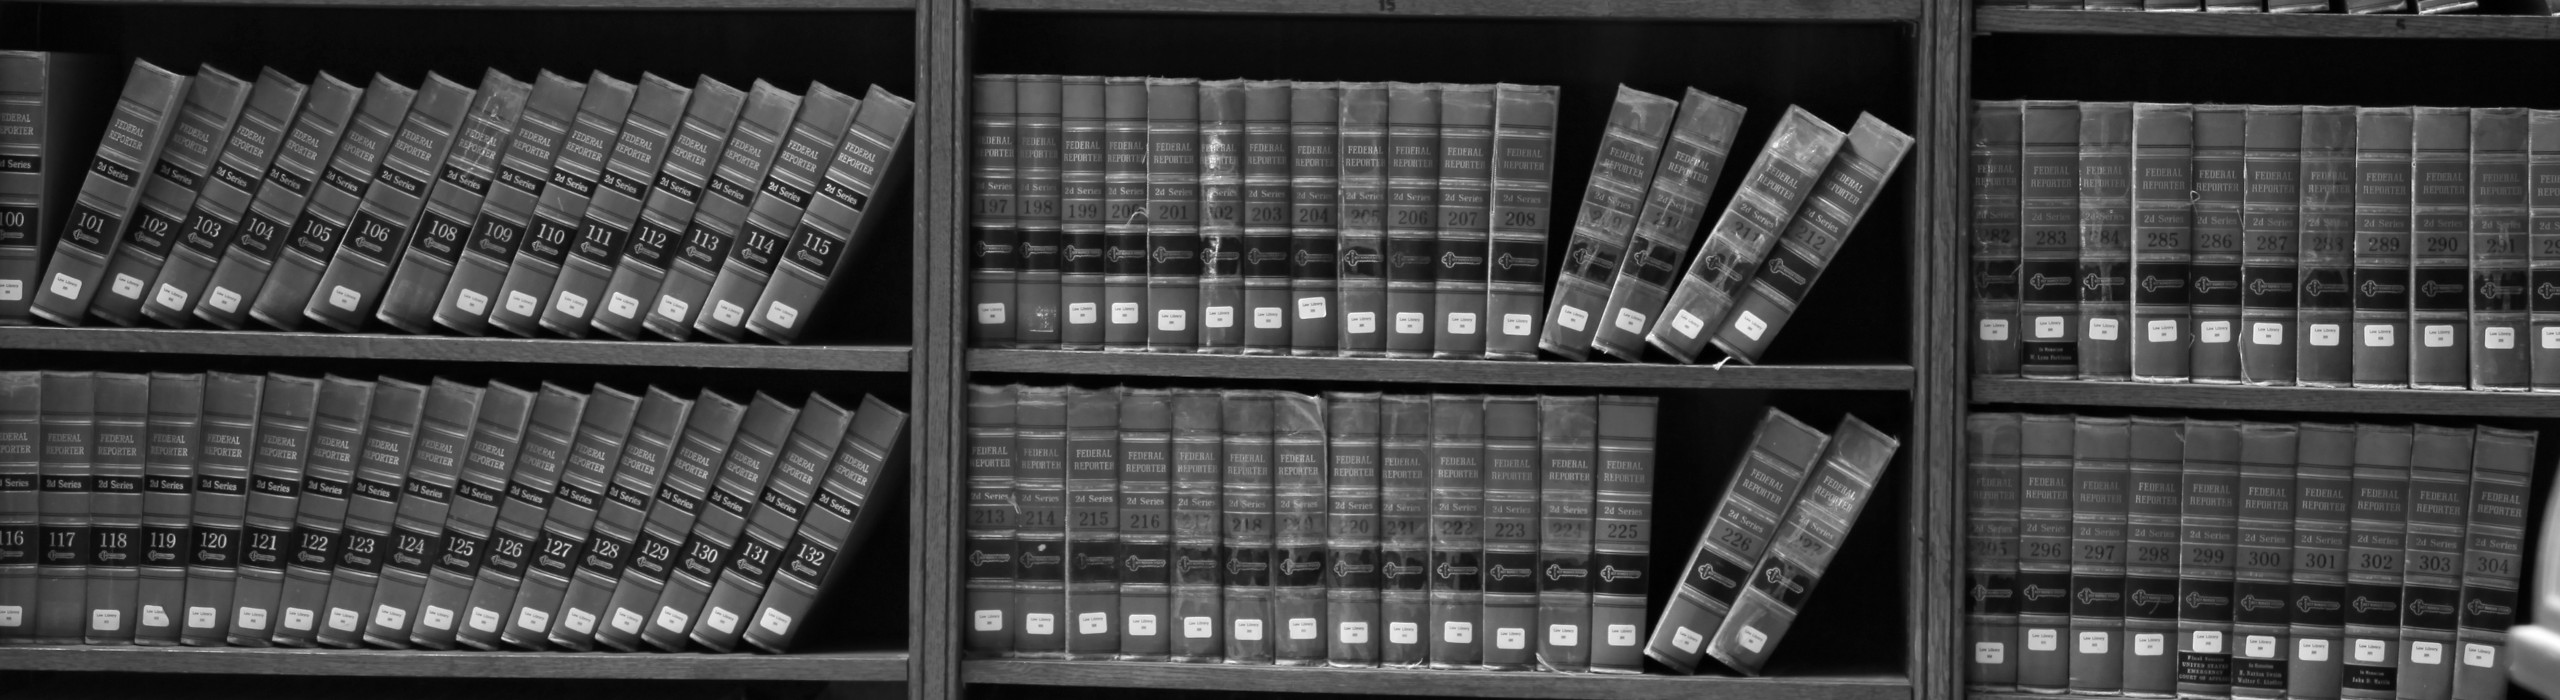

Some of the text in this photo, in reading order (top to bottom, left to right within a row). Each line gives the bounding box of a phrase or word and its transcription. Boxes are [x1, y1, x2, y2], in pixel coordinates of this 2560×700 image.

[115, 118, 144, 138] FEDERAL
[109, 130, 143, 150] REPORTER
[401, 129, 433, 149] FEDERAL
[571, 130, 604, 149] FEDERAL
[1156, 142, 1192, 152] FEDERAL
[395, 139, 432, 161] REPORTER
[566, 141, 603, 162] REPORTER
[844, 141, 876, 163] FEDERAL
[1447, 147, 1484, 157] FEDERAL
[838, 152, 874, 175] REPORTER
[1153, 155, 1194, 164] REPORTER
[1444, 159, 1486, 169] REPORTER
[97, 161, 129, 181] 2d Series
[2145, 167, 2183, 177] FEDERAL
[381, 170, 416, 191] 2d Series
[554, 173, 588, 192] 2d Series
[2142, 181, 2185, 190] REPORTER
[824, 183, 858, 206] 2d Series
[1155, 187, 1193, 196] 2d Series
[1444, 193, 1483, 203] 2d Series
[1069, 204, 1097, 218] 199
[1160, 204, 1189, 220] 201
[1252, 207, 1281, 221] 203
[1299, 209, 1328, 223] 204
[1398, 210, 1428, 225] 206
[1448, 210, 1478, 227] 207
[1505, 212, 1536, 226] 208
[2144, 214, 2184, 223] 2d Series
[78, 213, 102, 233] 101
[139, 214, 168, 236] 102
[193, 214, 222, 238] 103
[244, 217, 273, 240] 104
[304, 220, 330, 241] 105
[364, 219, 390, 242] 106
[431, 220, 458, 242] 108
[484, 223, 514, 242] 109
[537, 223, 565, 245] 110
[586, 224, 612, 246] 111
[639, 226, 667, 249] 112
[692, 228, 720, 252] 113
[1798, 226, 1826, 251] 212
[2036, 231, 2067, 245] 283
[2148, 232, 2178, 248] 285
[747, 230, 774, 255] 114
[803, 232, 832, 256] 115
[2201, 234, 2232, 248] 286
[2256, 236, 2288, 251] 287
[2368, 236, 2400, 252] 289
[2427, 237, 2458, 252] 290
[47, 433, 82, 443] FEDERAL
[263, 434, 296, 447] FEDERAL
[46, 446, 85, 455] REPORTER
[260, 446, 298, 460] REPORTER
[1076, 449, 1113, 458] FEDERAL
[840, 452, 870, 473] FEDERAL
[1074, 461, 1115, 470] REPORTER
[1607, 460, 1644, 471] FEDERAL
[833, 462, 868, 486] REPORTER
[1603, 472, 1645, 483] REPORTER
[1750, 468, 1784, 493] FEDERAL
[2029, 477, 2066, 487] FEDERAL
[46, 479, 82, 489] 2d Series
[256, 479, 290, 493] 2d Series
[1742, 478, 1782, 505] REPORTER
[1075, 494, 1114, 503] 2d Series
[2025, 489, 2068, 500] REPORTER
[2482, 491, 2521, 505] FEDERAL
[819, 493, 851, 515] 2d Series
[1604, 506, 1643, 516] 2d Series
[2477, 503, 2522, 518] REPORTER
[1079, 511, 1109, 527] 215
[1130, 514, 1160, 529] 216
[1728, 509, 1764, 533] 2d Series
[1495, 523, 1526, 538] 223
[1608, 523, 1638, 539] 225
[2026, 523, 2066, 533] 2d Series
[49, 532, 76, 547] 117
[100, 532, 128, 548] 118
[150, 533, 176, 549] 119
[200, 533, 228, 549] 120
[251, 533, 278, 551] 121
[301, 535, 329, 552] 122
[348, 535, 375, 554] 123
[398, 534, 424, 555] 124
[448, 536, 474, 556] 125
[495, 537, 523, 557] 126
[1721, 527, 1752, 552] 226
[2475, 537, 2518, 551] 2d Series
[544, 538, 573, 558] 127
[591, 538, 620, 559] 128
[641, 539, 670, 561] 129
[691, 541, 718, 563] 130
[743, 542, 770, 565] 131
[797, 543, 826, 567] 132
[2030, 542, 2061, 558] 296
[2084, 545, 2115, 561] 297
[2138, 547, 2170, 562] 298
[2193, 549, 2225, 563] 299
[2248, 552, 2280, 567] 300
[2305, 553, 2336, 569] 301
[2361, 554, 2393, 570] 302
[2419, 556, 2451, 572] 303
[2478, 557, 2508, 574] 304
